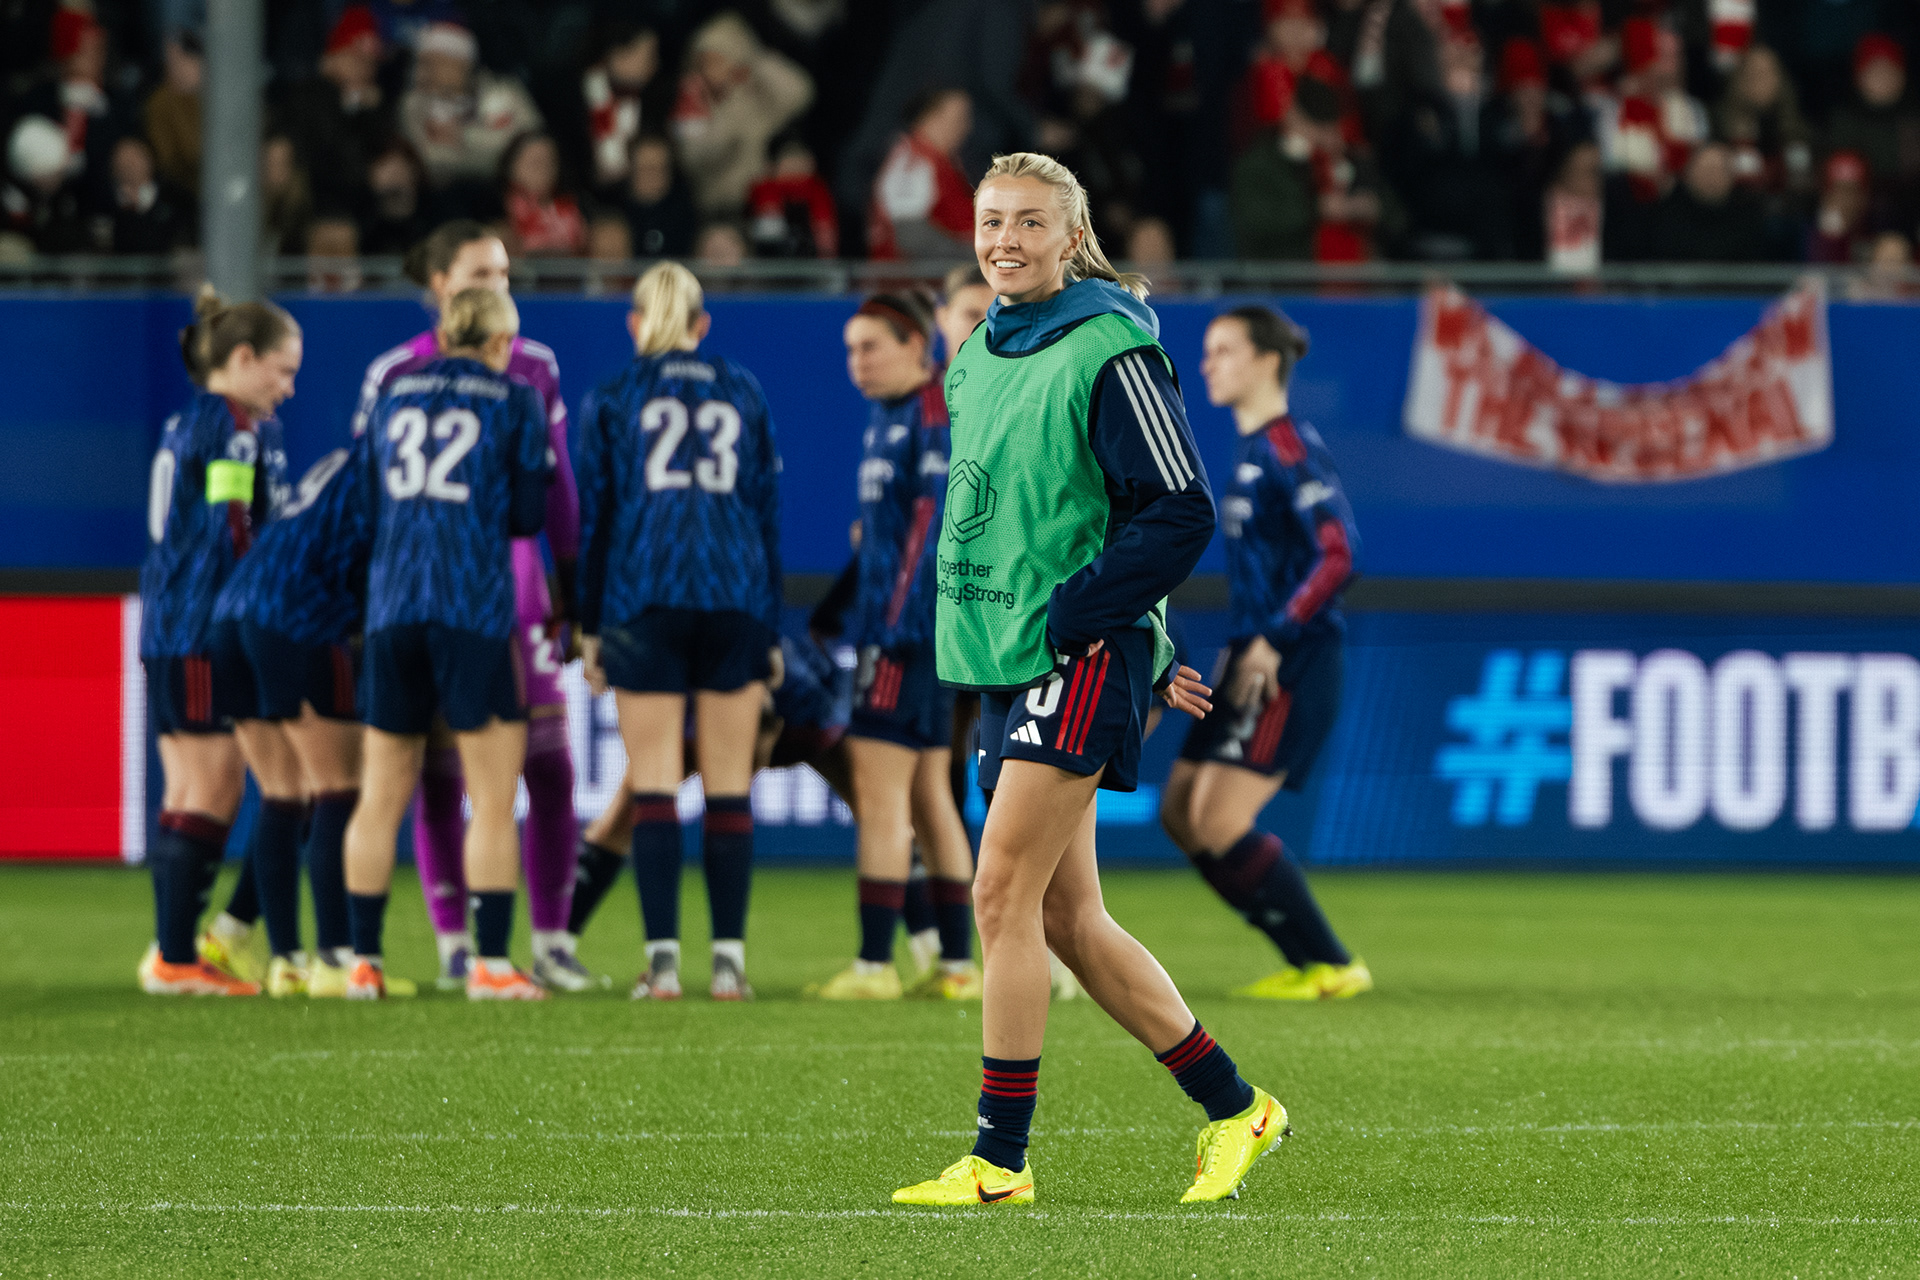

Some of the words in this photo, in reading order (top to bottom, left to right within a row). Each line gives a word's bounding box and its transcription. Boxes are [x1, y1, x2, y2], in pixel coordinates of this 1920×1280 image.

[385, 406, 481, 502] 32
[640, 397, 742, 494] 23
[1434, 648, 1920, 832] #FOOTB
